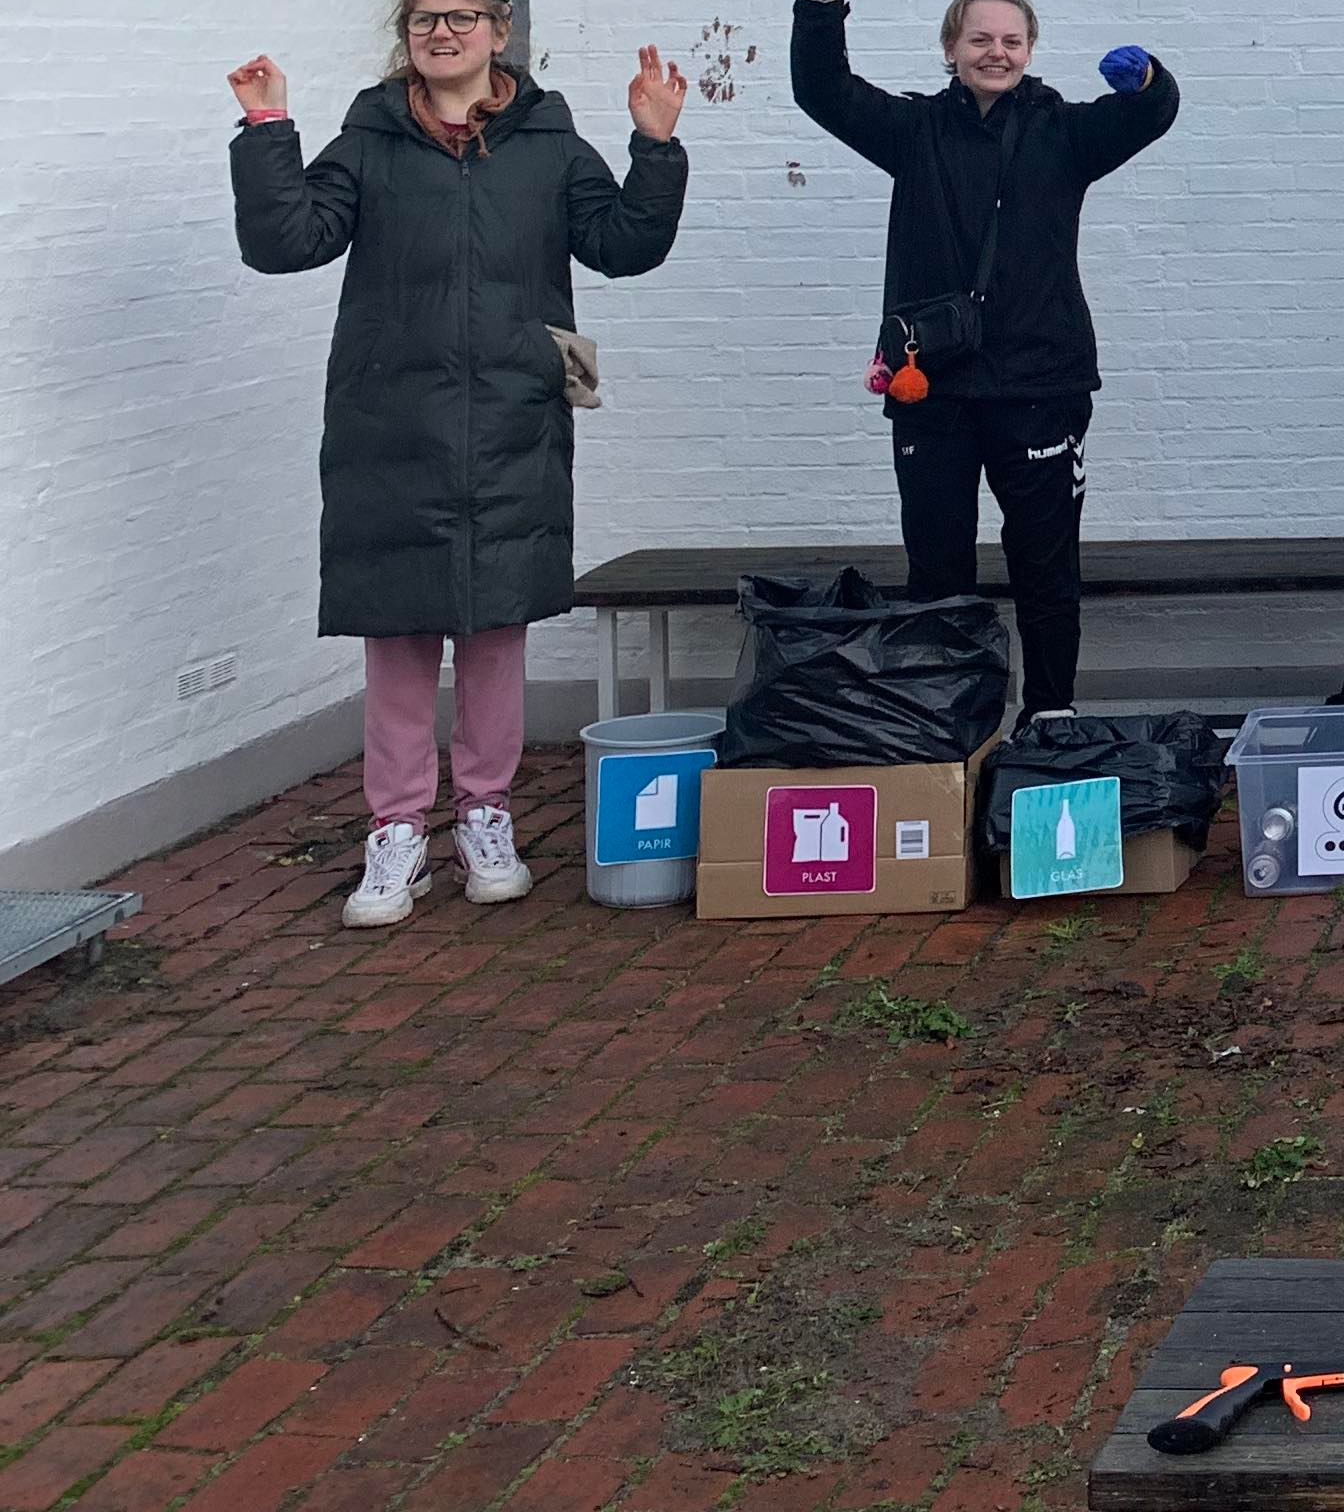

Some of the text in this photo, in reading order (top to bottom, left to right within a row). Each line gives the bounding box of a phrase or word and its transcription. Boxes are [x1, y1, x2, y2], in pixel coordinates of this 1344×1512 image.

[637, 838, 672, 850] PAPIR
[802, 871, 837, 883] PLAST
[1050, 868, 1083, 882] GLAS
